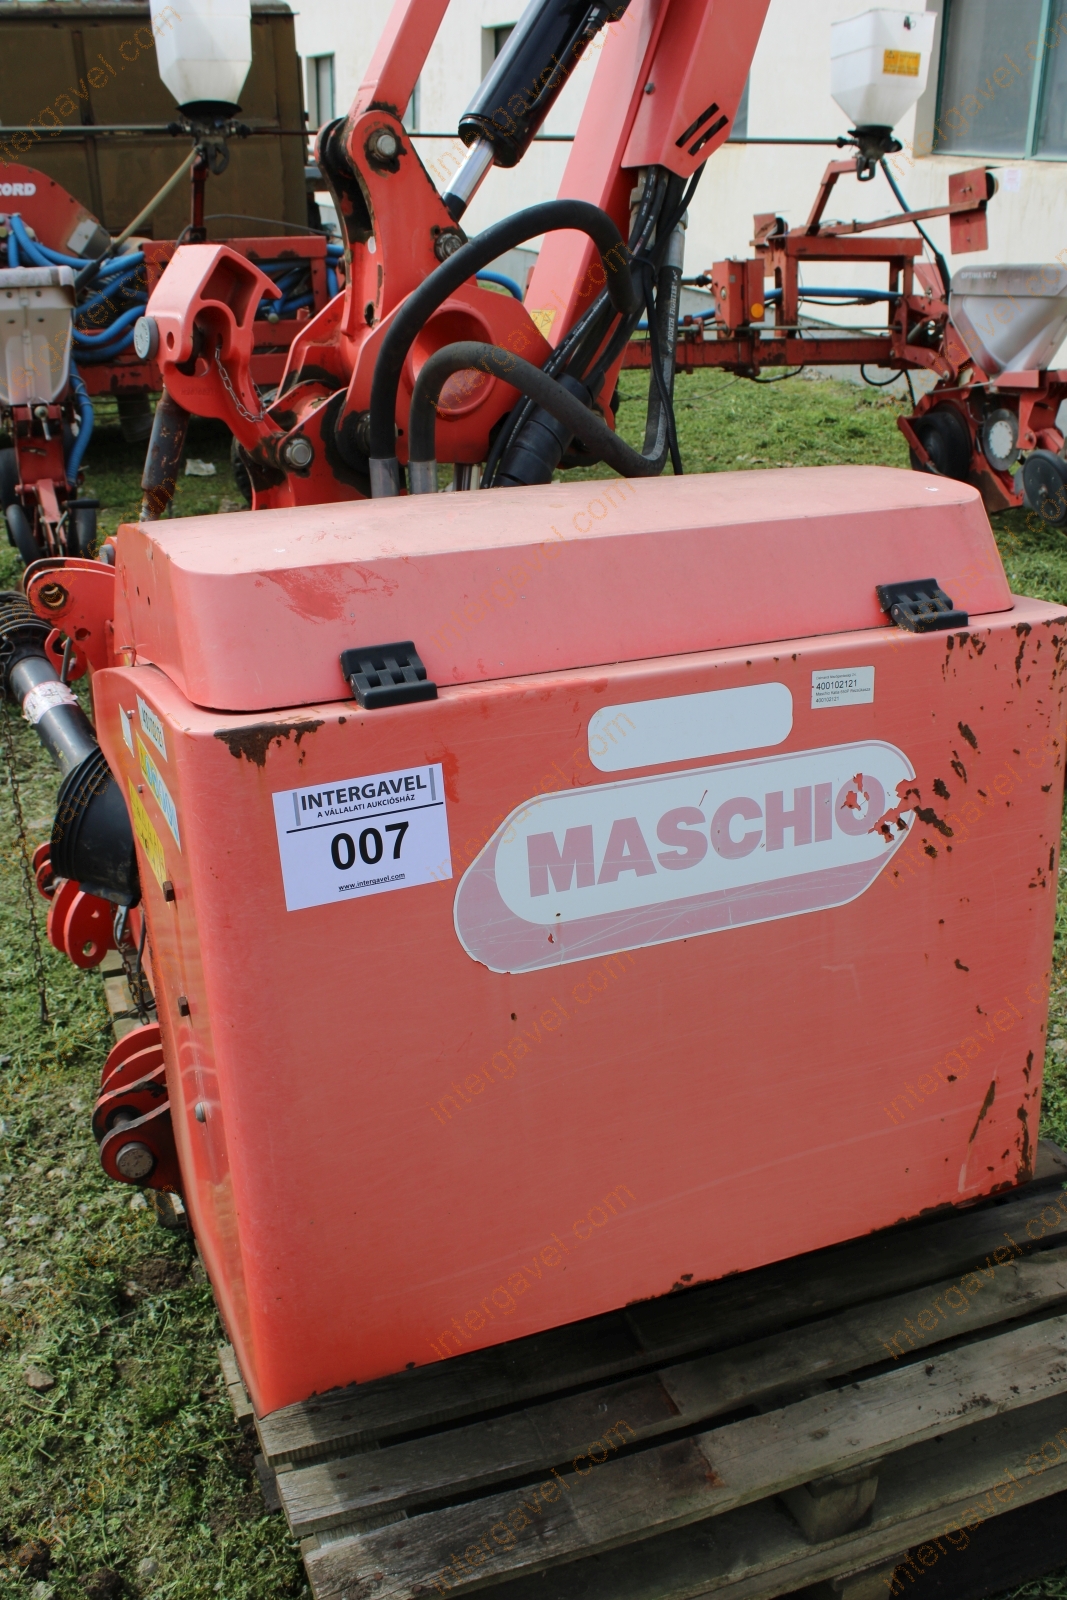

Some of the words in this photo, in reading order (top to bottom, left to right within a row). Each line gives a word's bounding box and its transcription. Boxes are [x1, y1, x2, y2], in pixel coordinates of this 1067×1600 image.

[0, 183, 36, 196] ORD
[816, 679, 857, 690] 400102121
[301, 774, 427, 811] INTERGAVEL
[324, 803, 366, 817] VÁLLALATI
[366, 794, 416, 809] AUKCIÓSHÁZ
[330, 820, 410, 870] 007
[526, 774, 886, 898] MASCHIO
[338, 872, 406, 891] www.intergavel.com
